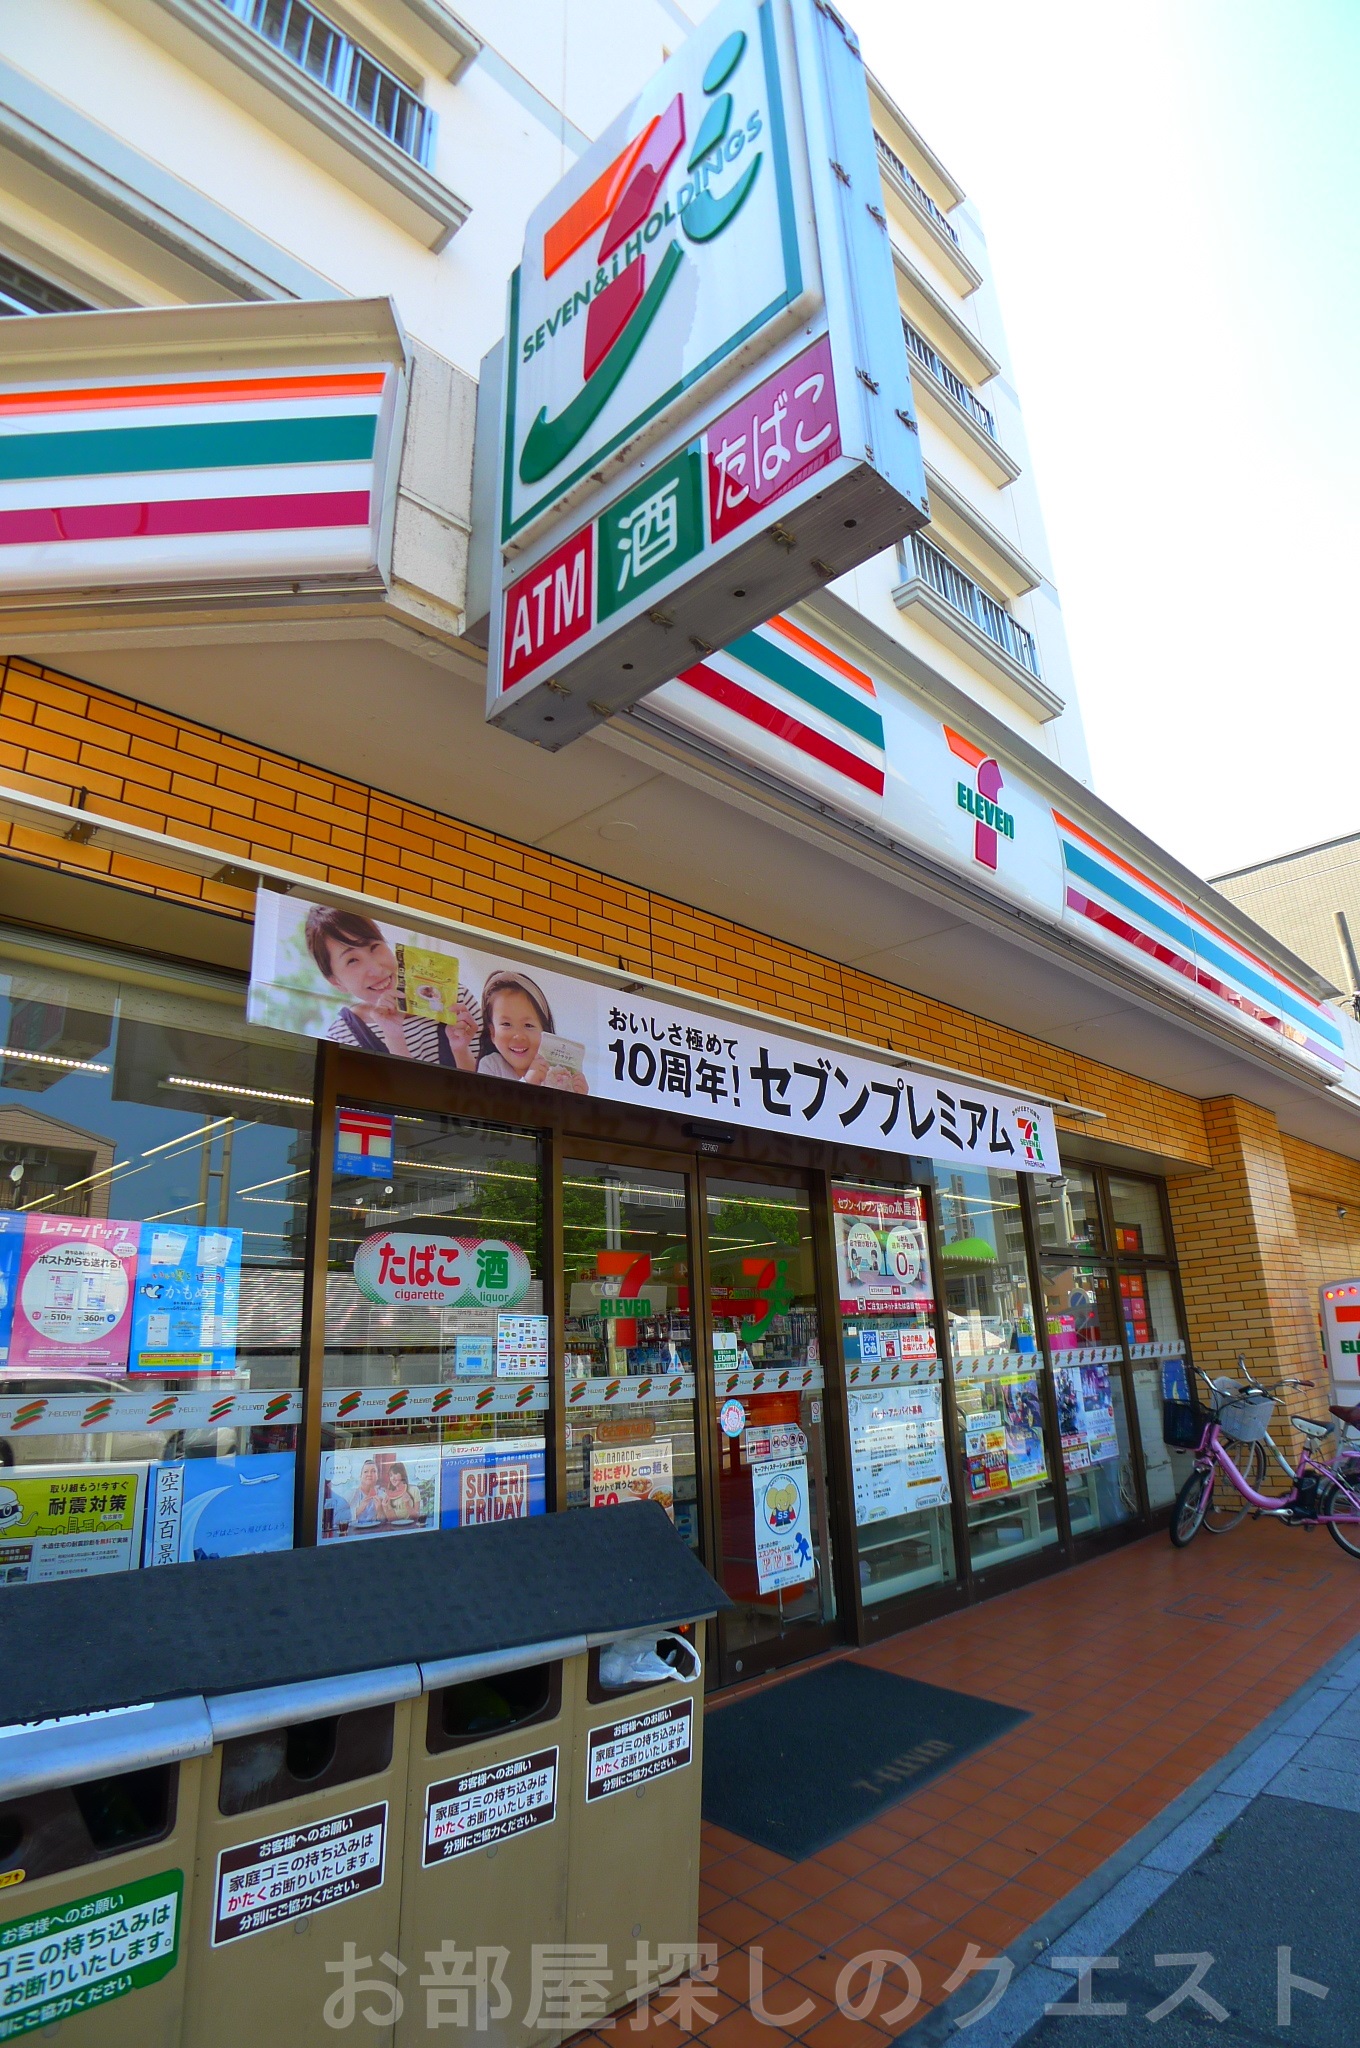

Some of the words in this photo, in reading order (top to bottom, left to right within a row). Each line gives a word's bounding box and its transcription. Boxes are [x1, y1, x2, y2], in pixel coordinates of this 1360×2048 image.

[625, 109, 763, 266] HOLDINGS
[714, 372, 832, 520] たばこ
[617, 476, 680, 592] 酒
[508, 548, 586, 669] ATM
[957, 781, 1015, 840] ELEVEN
[608, 1006, 739, 1060] おいしさ極めて
[608, 1038, 741, 1108] 10周年!
[750, 1047, 1015, 1157] セブンプレミアム
[40, 1221, 130, 1240] レターパック
[378, 1242, 461, 1287] たばこ
[476, 1248, 509, 1289] 酒
[394, 1288, 445, 1301] cigarette
[480, 1291, 509, 1304] liquor
[600, 1298, 652, 1318] ELEVEN
[50, 1313, 72, 1321] 510円
[50, 1481, 129, 1494] 取り組もう!今すぐ
[465, 1469, 525, 1499] SUPER!
[593, 1480, 633, 1493] セットで買うと
[48, 1494, 127, 1517] 耐震対策
[158, 1471, 180, 1564] 空旅百景
[465, 1494, 524, 1525] FRIDAY
[595, 1721, 685, 1762] 家庭ゴミの持ち込みは
[613, 1709, 672, 1736] お客様へのお願い
[458, 1760, 532, 1791] お客様へのお願い
[595, 1736, 686, 1777] かたくお断りいたします。
[602, 1756, 677, 1792] 分別にご協力ください。
[434, 1789, 548, 1838] かたくお断りいたします。
[435, 1773, 548, 1821] 家庭ゴミの持ち込みは
[259, 1818, 353, 1857] お客様へのお願い
[443, 1813, 538, 1856] 分別にご協力ください。
[227, 1852, 375, 1912] かたくお断りいたします。
[229, 1833, 374, 1893] 家庭ゴミの持ち込みは
[2, 1894, 124, 1945] お客様へのお願い
[239, 1879, 360, 1931] 分別にご協力ください。
[3, 1930, 172, 2007] お断りいたします。
